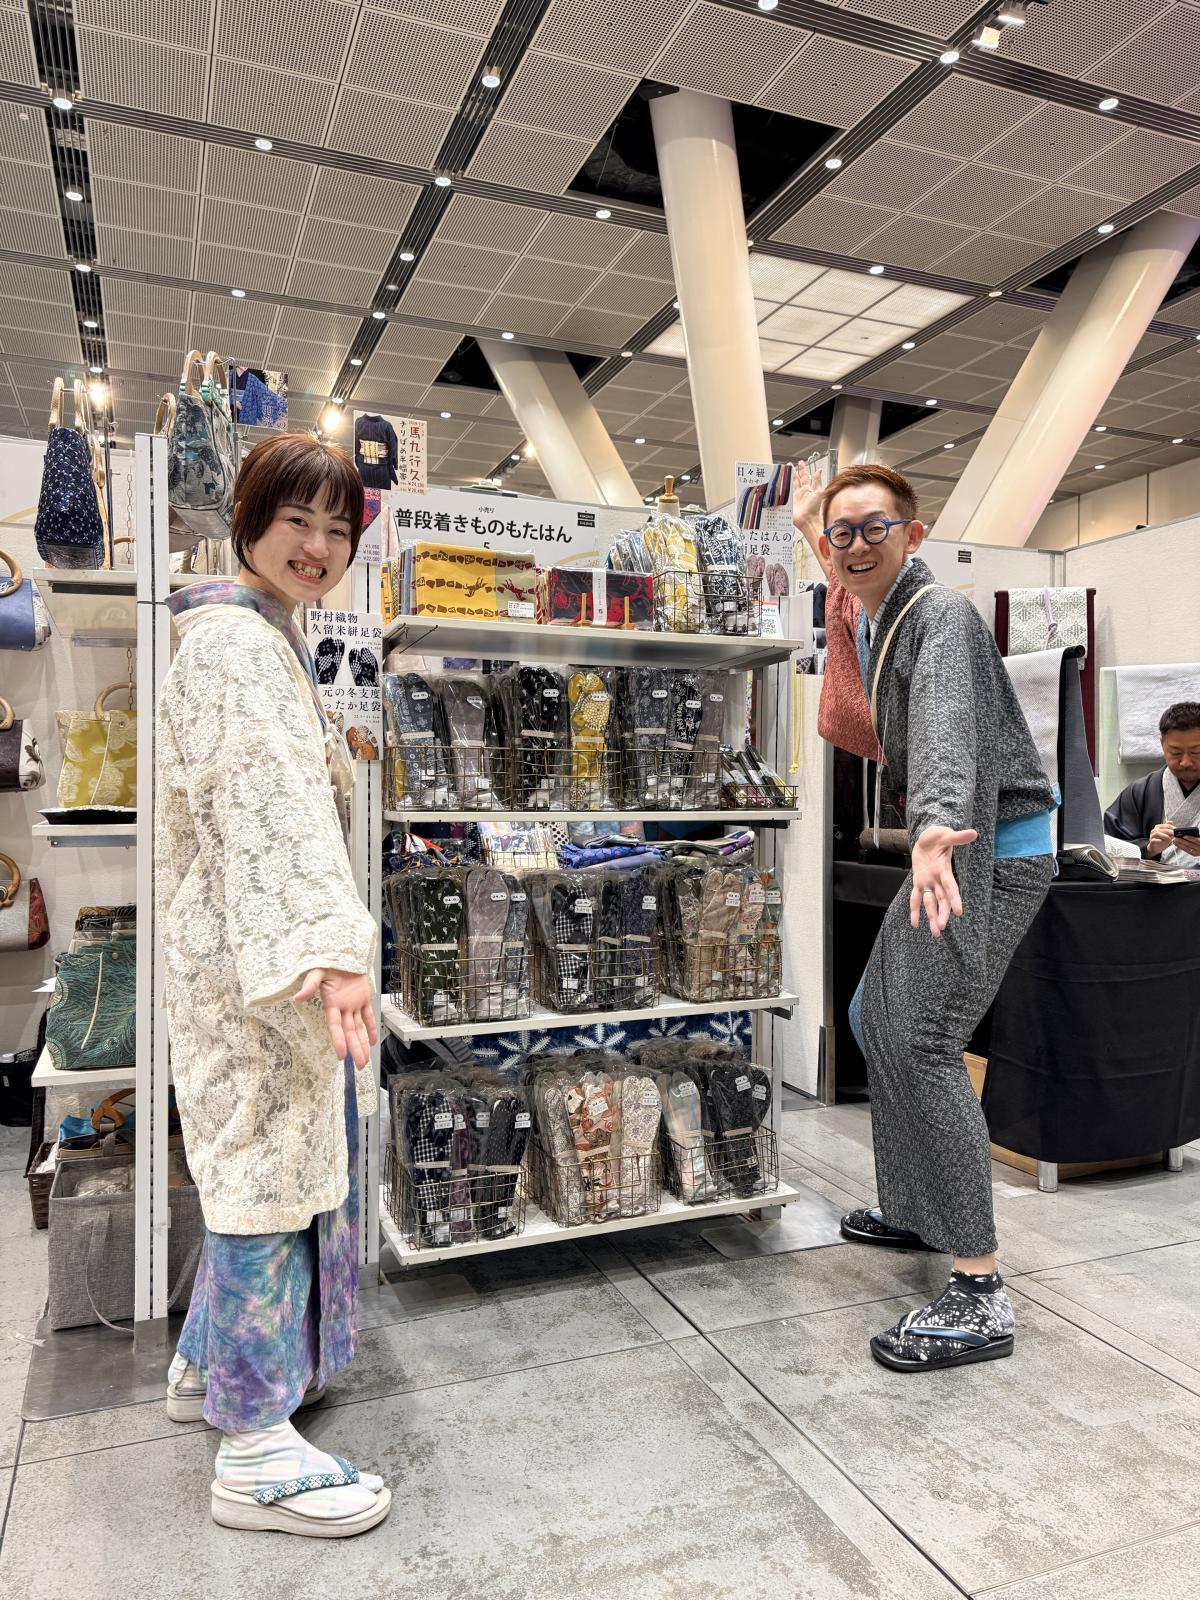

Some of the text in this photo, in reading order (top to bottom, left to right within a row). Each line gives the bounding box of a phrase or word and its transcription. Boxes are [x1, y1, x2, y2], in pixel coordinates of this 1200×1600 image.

[478, 506, 495, 514] 小売り
[395, 507, 573, 544] 普段着きものもたはん
[310, 610, 358, 624] 野村織物
[311, 623, 382, 639] 久留米絣足袋
